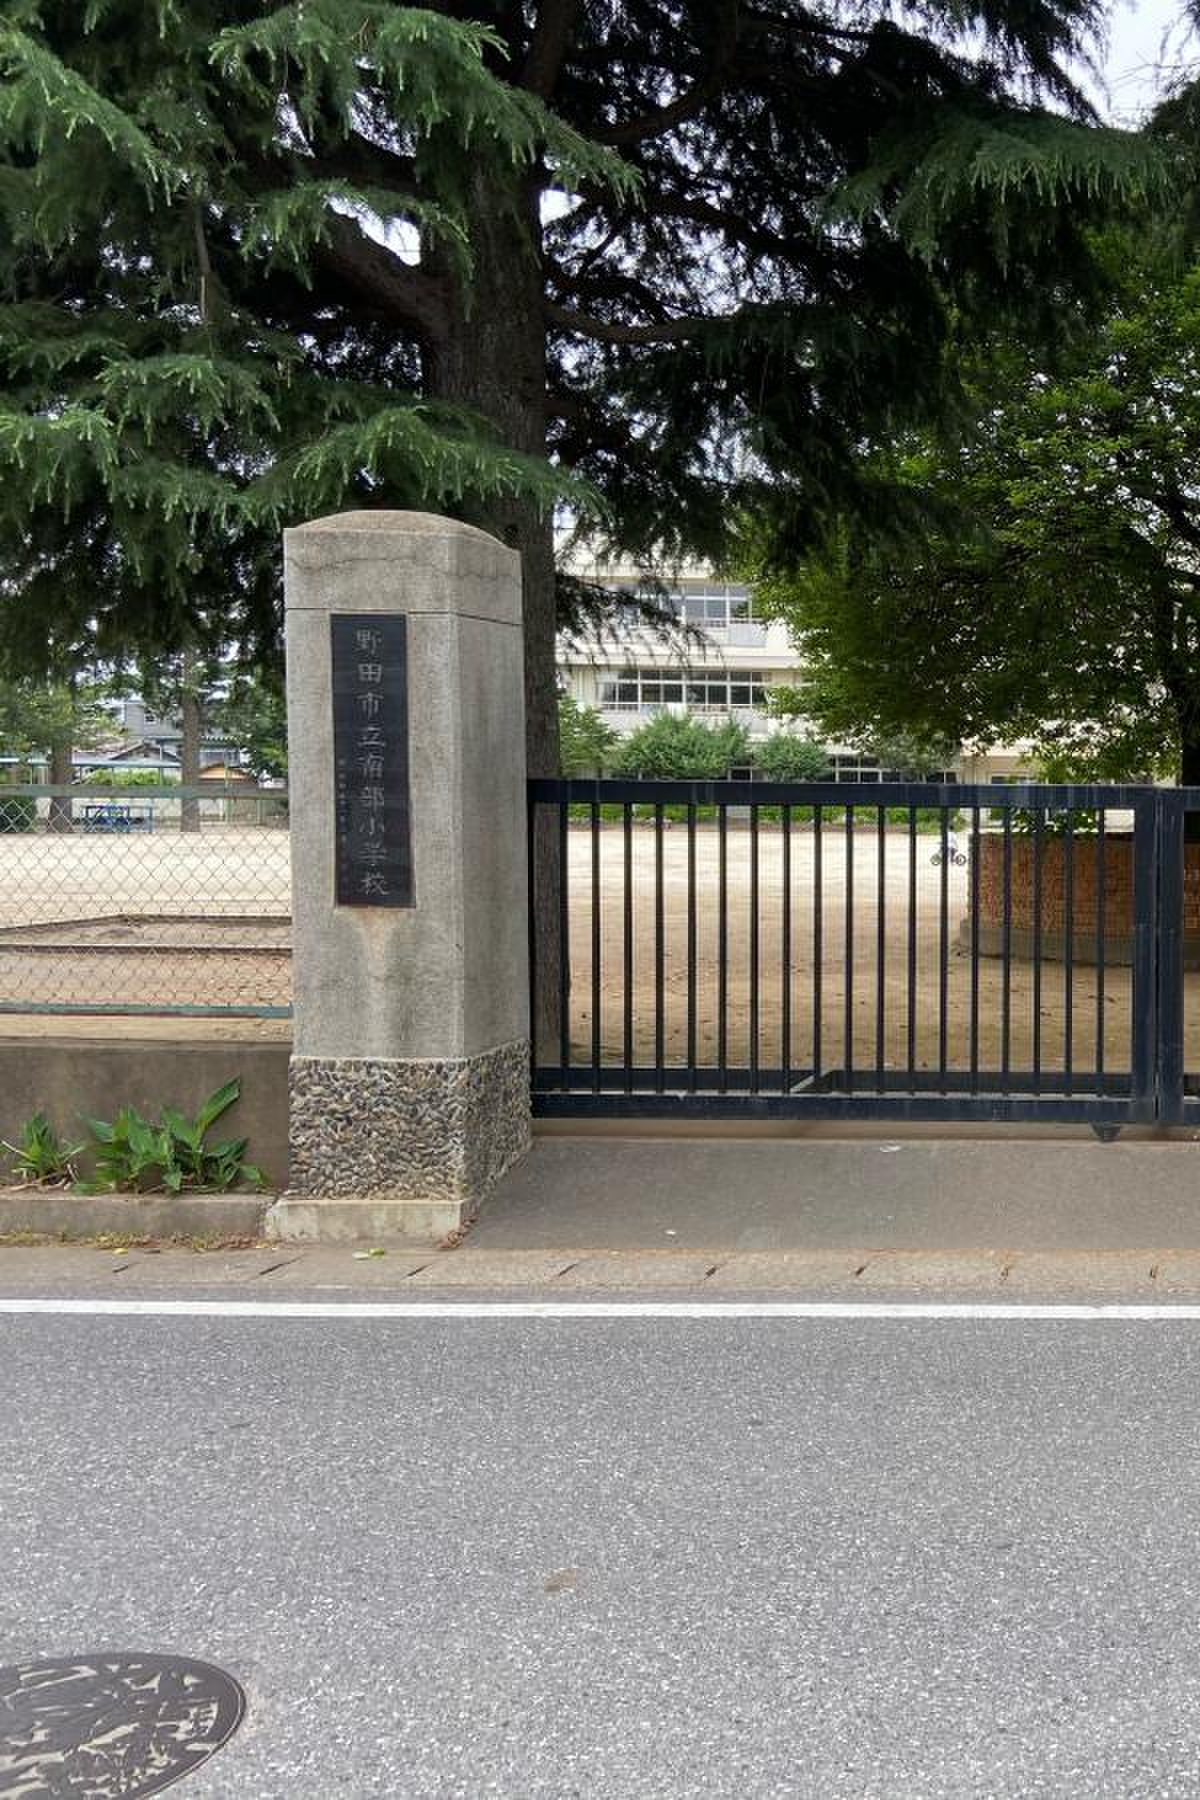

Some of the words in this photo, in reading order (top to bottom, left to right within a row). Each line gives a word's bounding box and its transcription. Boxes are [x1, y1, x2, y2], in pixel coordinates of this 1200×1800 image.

[354, 626, 390, 896] 野田市立南部小学校
